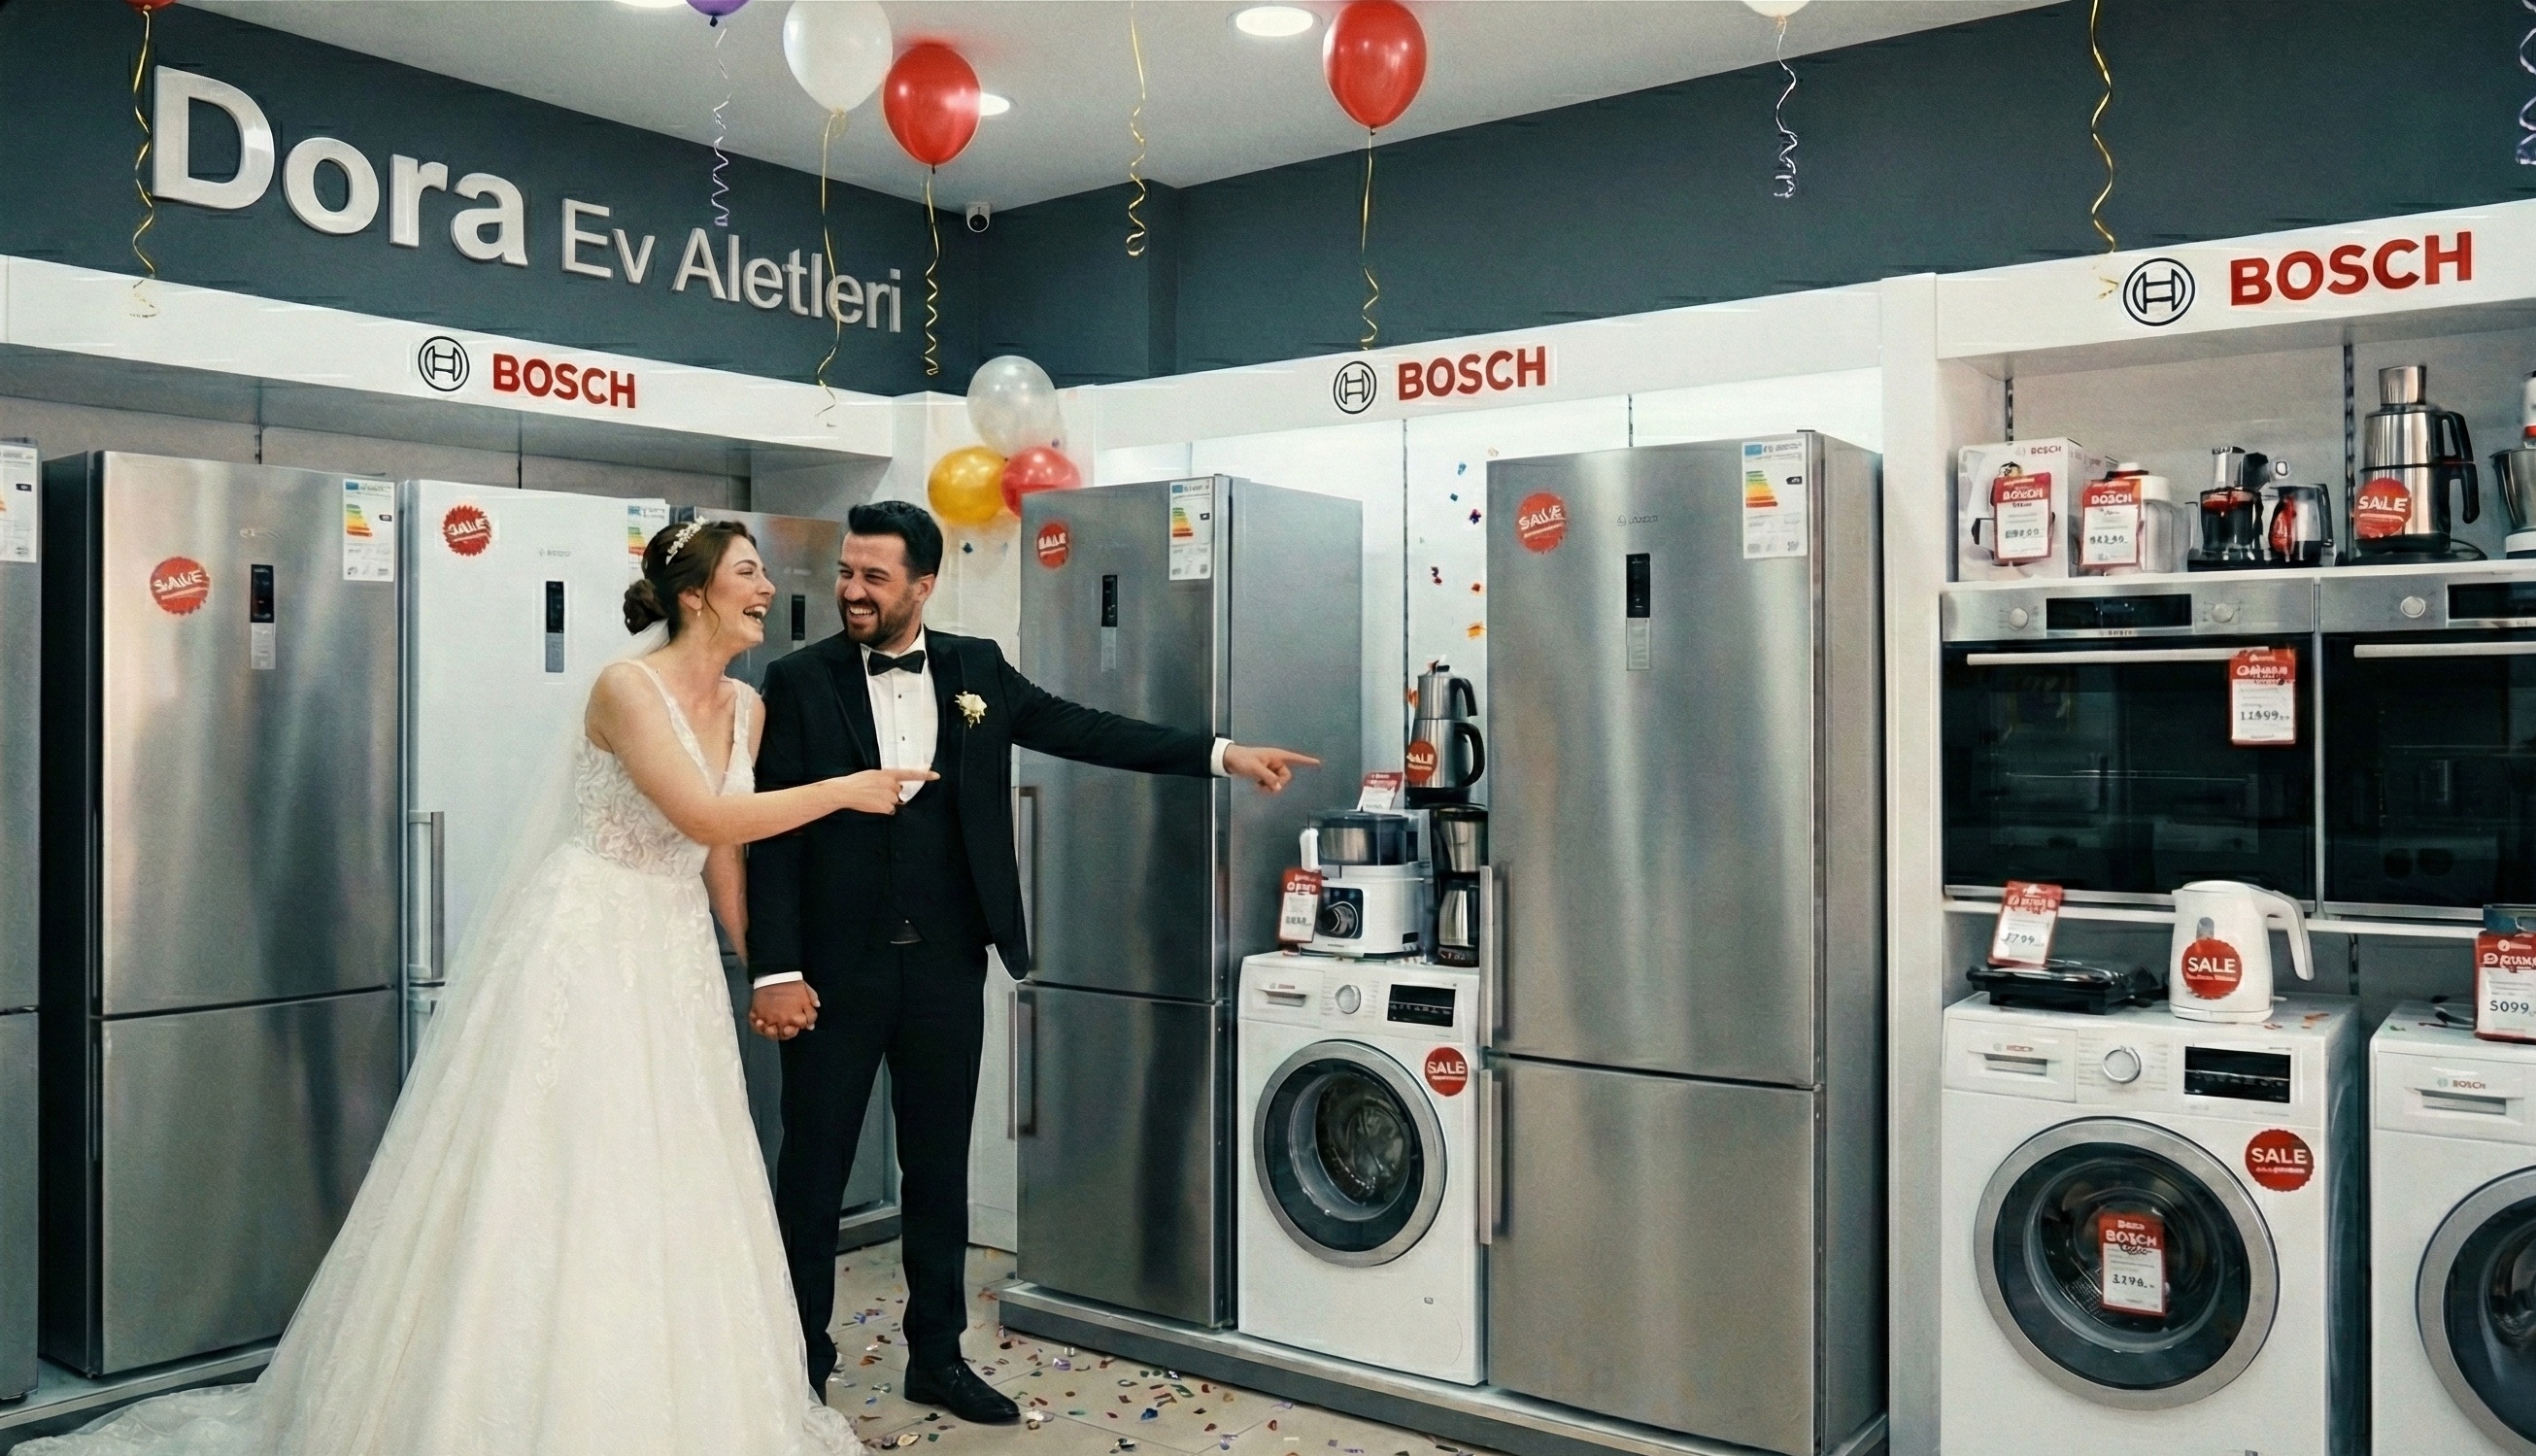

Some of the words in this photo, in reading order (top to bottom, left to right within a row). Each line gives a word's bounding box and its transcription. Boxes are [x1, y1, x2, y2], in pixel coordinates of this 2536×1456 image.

[152, 64, 528, 267] Dora
[561, 197, 656, 284] Ev
[672, 227, 901, 333] Aletleri
[2230, 231, 2472, 306] BOSCH
[492, 353, 636, 409] BOSCH
[1398, 346, 1546, 401] BOSCH
[2358, 495, 2409, 513] SALE
[2187, 957, 2236, 973] SALE
[1427, 1061, 1466, 1074] SALE
[2250, 1147, 2308, 1165] SALE
